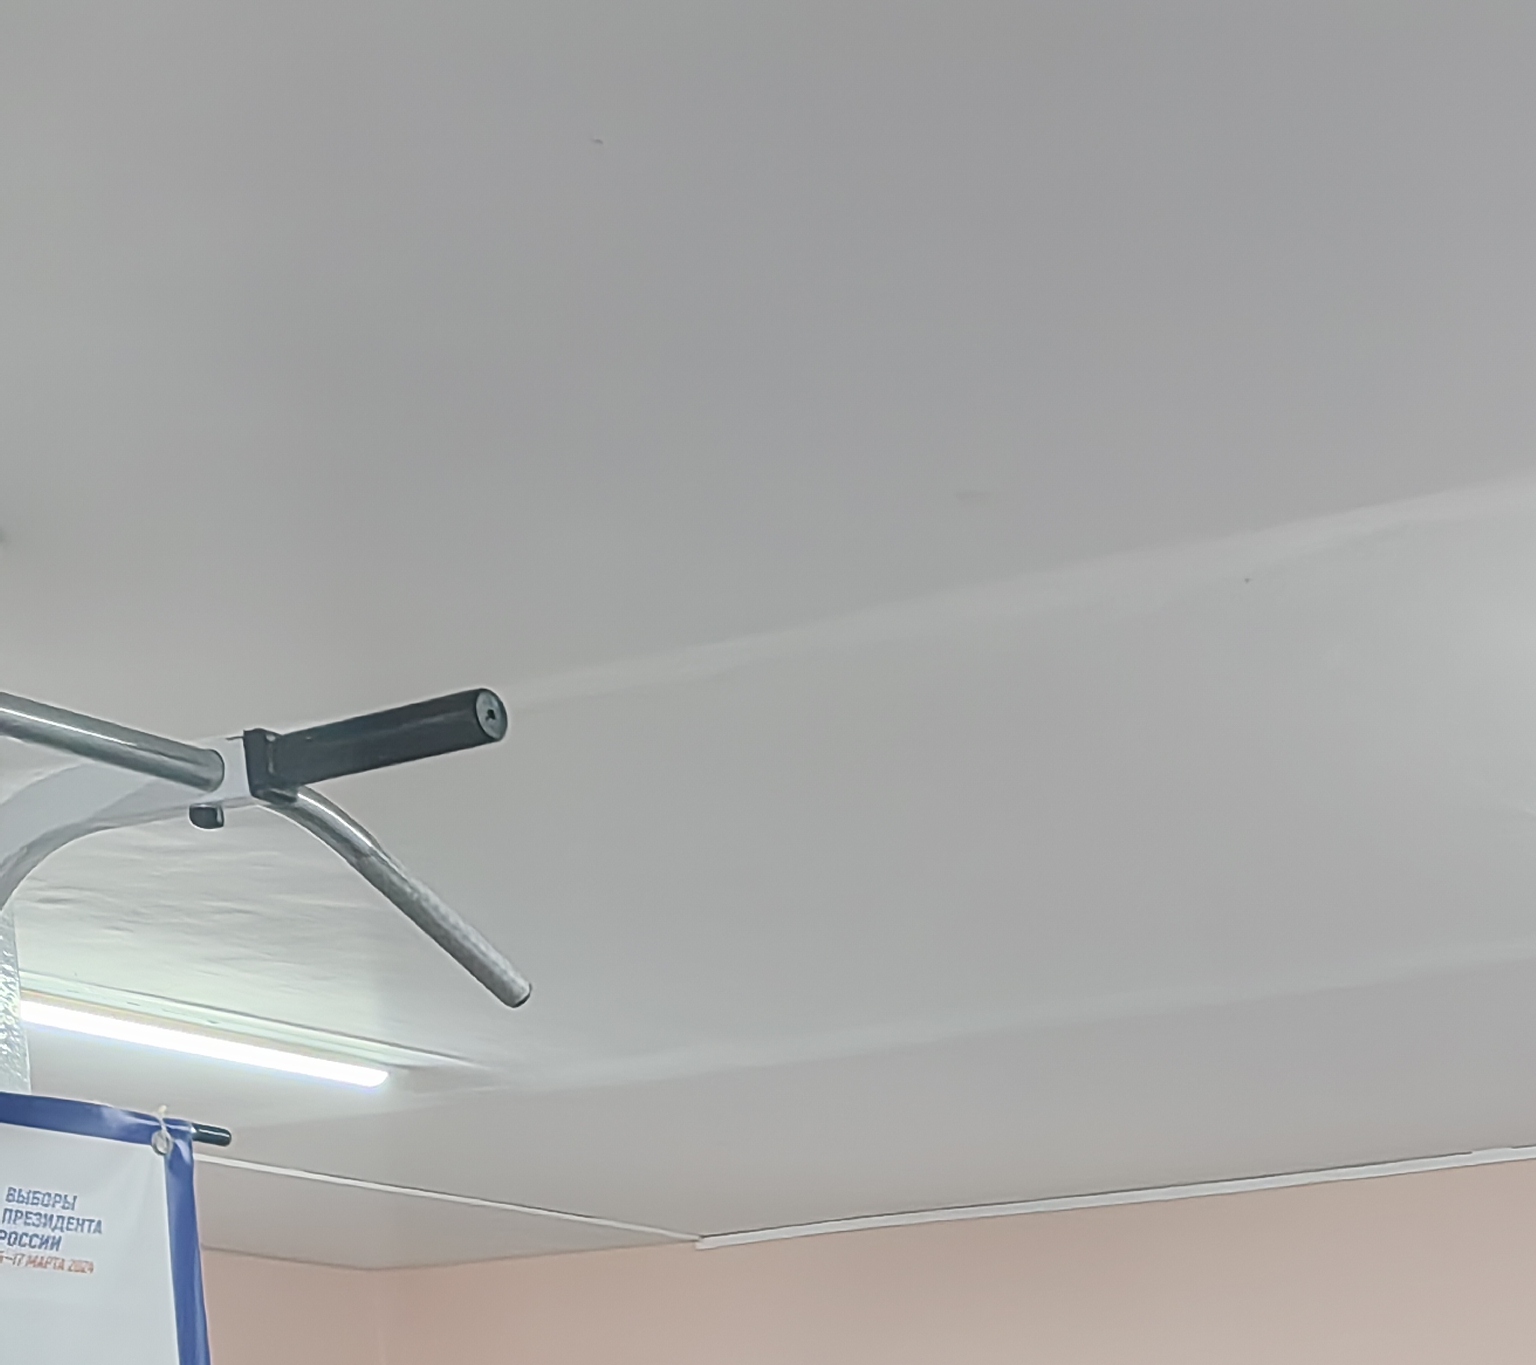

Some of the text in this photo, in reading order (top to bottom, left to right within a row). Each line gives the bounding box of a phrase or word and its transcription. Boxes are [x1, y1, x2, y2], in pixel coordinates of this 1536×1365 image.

[5, 1186, 78, 1211] ВЫБОРЫ
[2, 1207, 103, 1234] ПРЕЗИДЕНТА
[0, 1229, 63, 1252] РОССИИ
[26, 1254, 66, 1271] МАРТА
